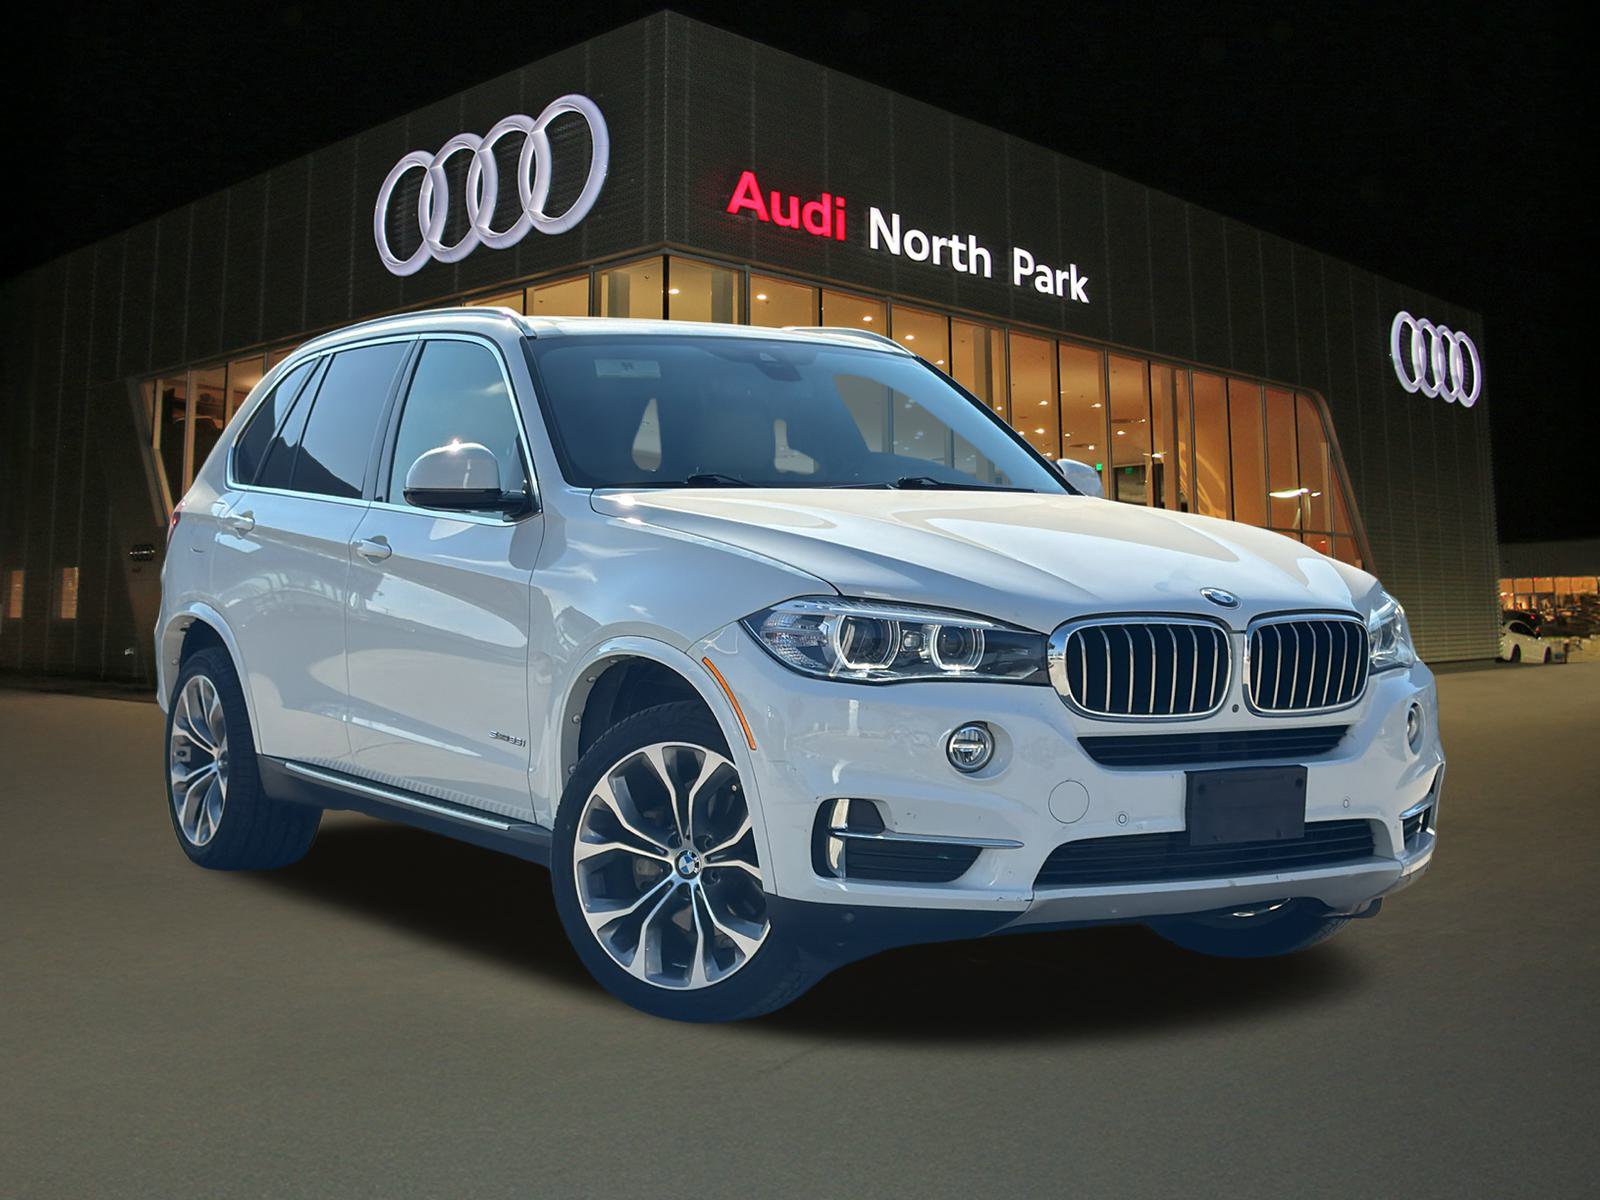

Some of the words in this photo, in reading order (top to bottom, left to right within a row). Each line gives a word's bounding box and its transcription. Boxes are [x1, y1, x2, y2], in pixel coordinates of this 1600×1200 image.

[727, 171, 846, 241] Audi
[869, 206, 992, 278] North
[1013, 246, 1090, 304] Park
